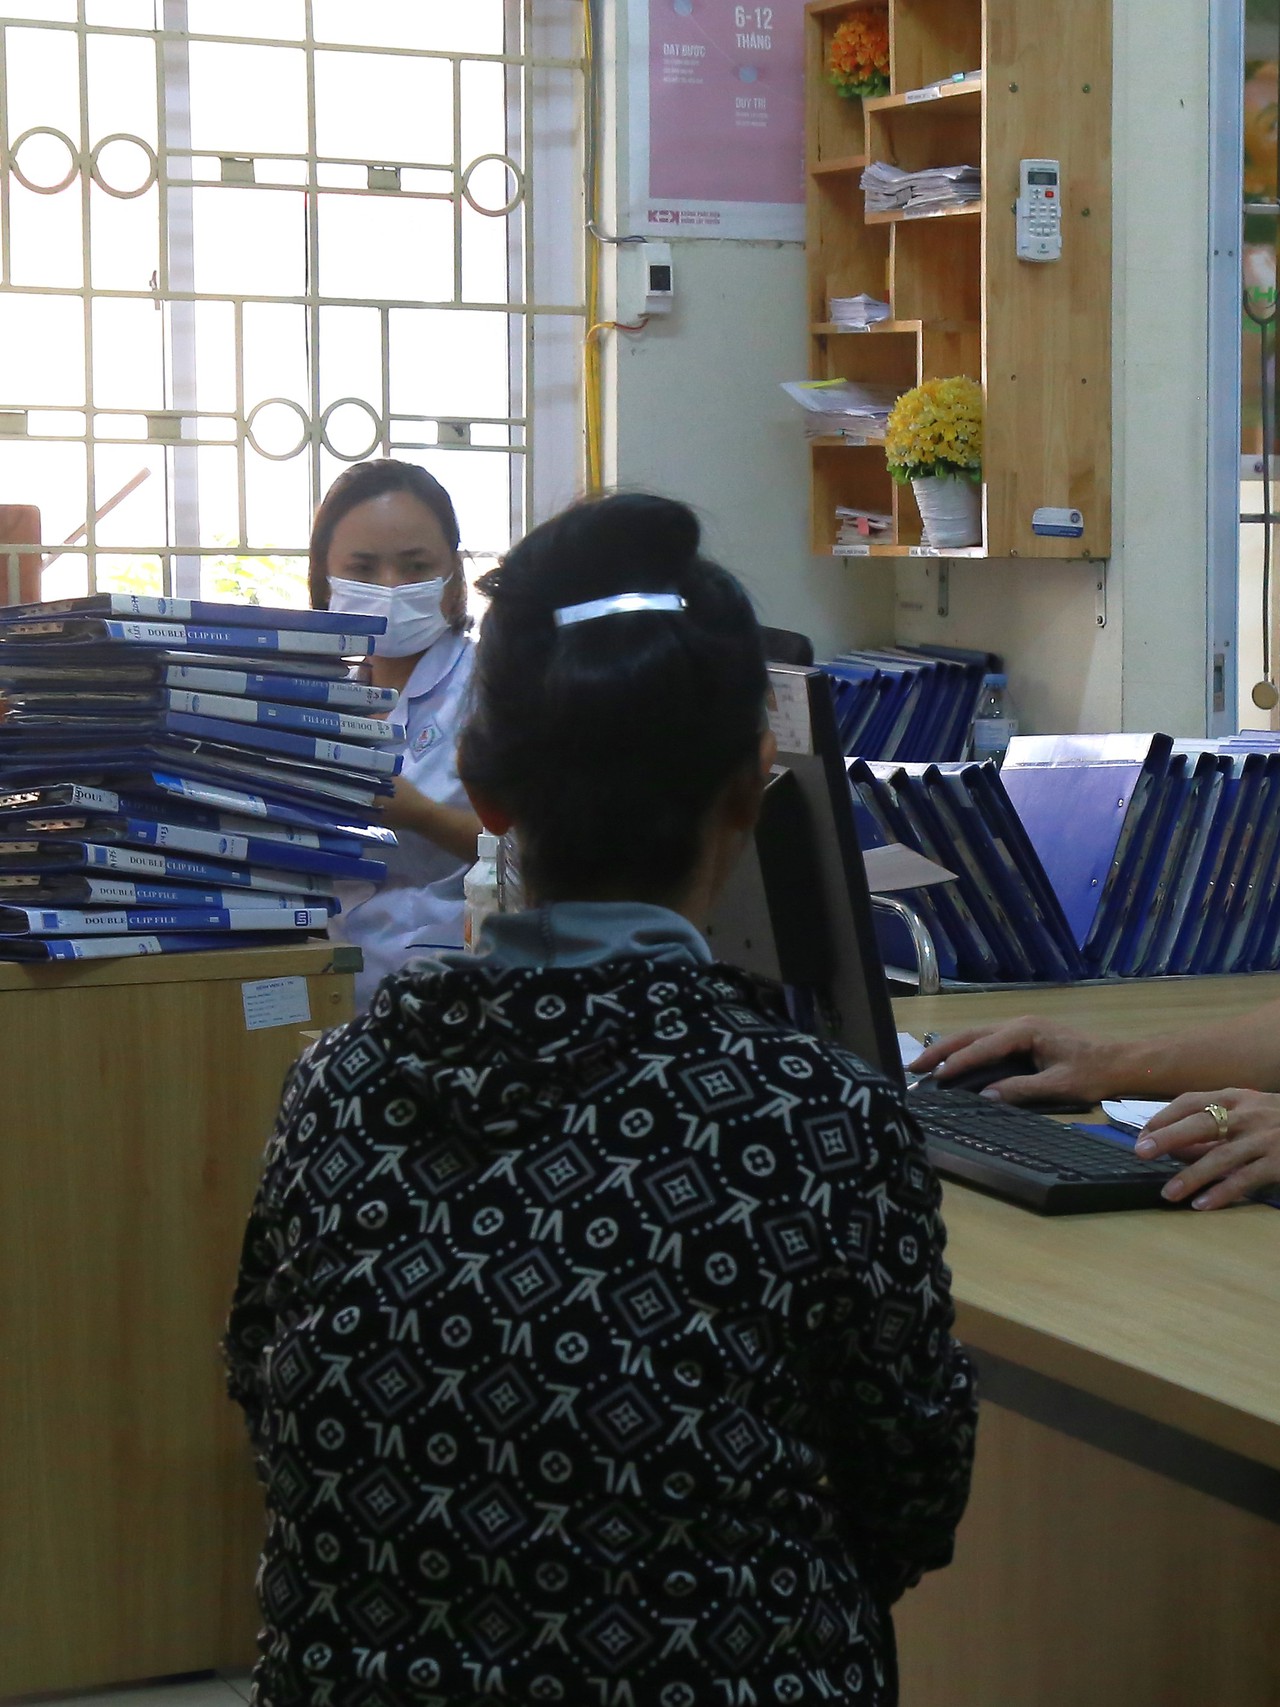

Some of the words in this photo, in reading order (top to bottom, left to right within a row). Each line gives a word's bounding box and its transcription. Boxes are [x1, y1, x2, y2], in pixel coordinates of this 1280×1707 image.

[148, 628, 187, 638] DOUBLE
[188, 632, 210, 640] CLIP
[210, 632, 232, 641] FILE
[130, 856, 164, 868] DOUBLE
[166, 862, 186, 870] CLIP
[187, 864, 206, 874] FILE
[100, 887, 134, 896] DOUBLE
[137, 890, 157, 898] CLIP
[158, 891, 178, 900] FILE
[129, 916, 154, 924] CLIP
[154, 916, 177, 924] FILE
